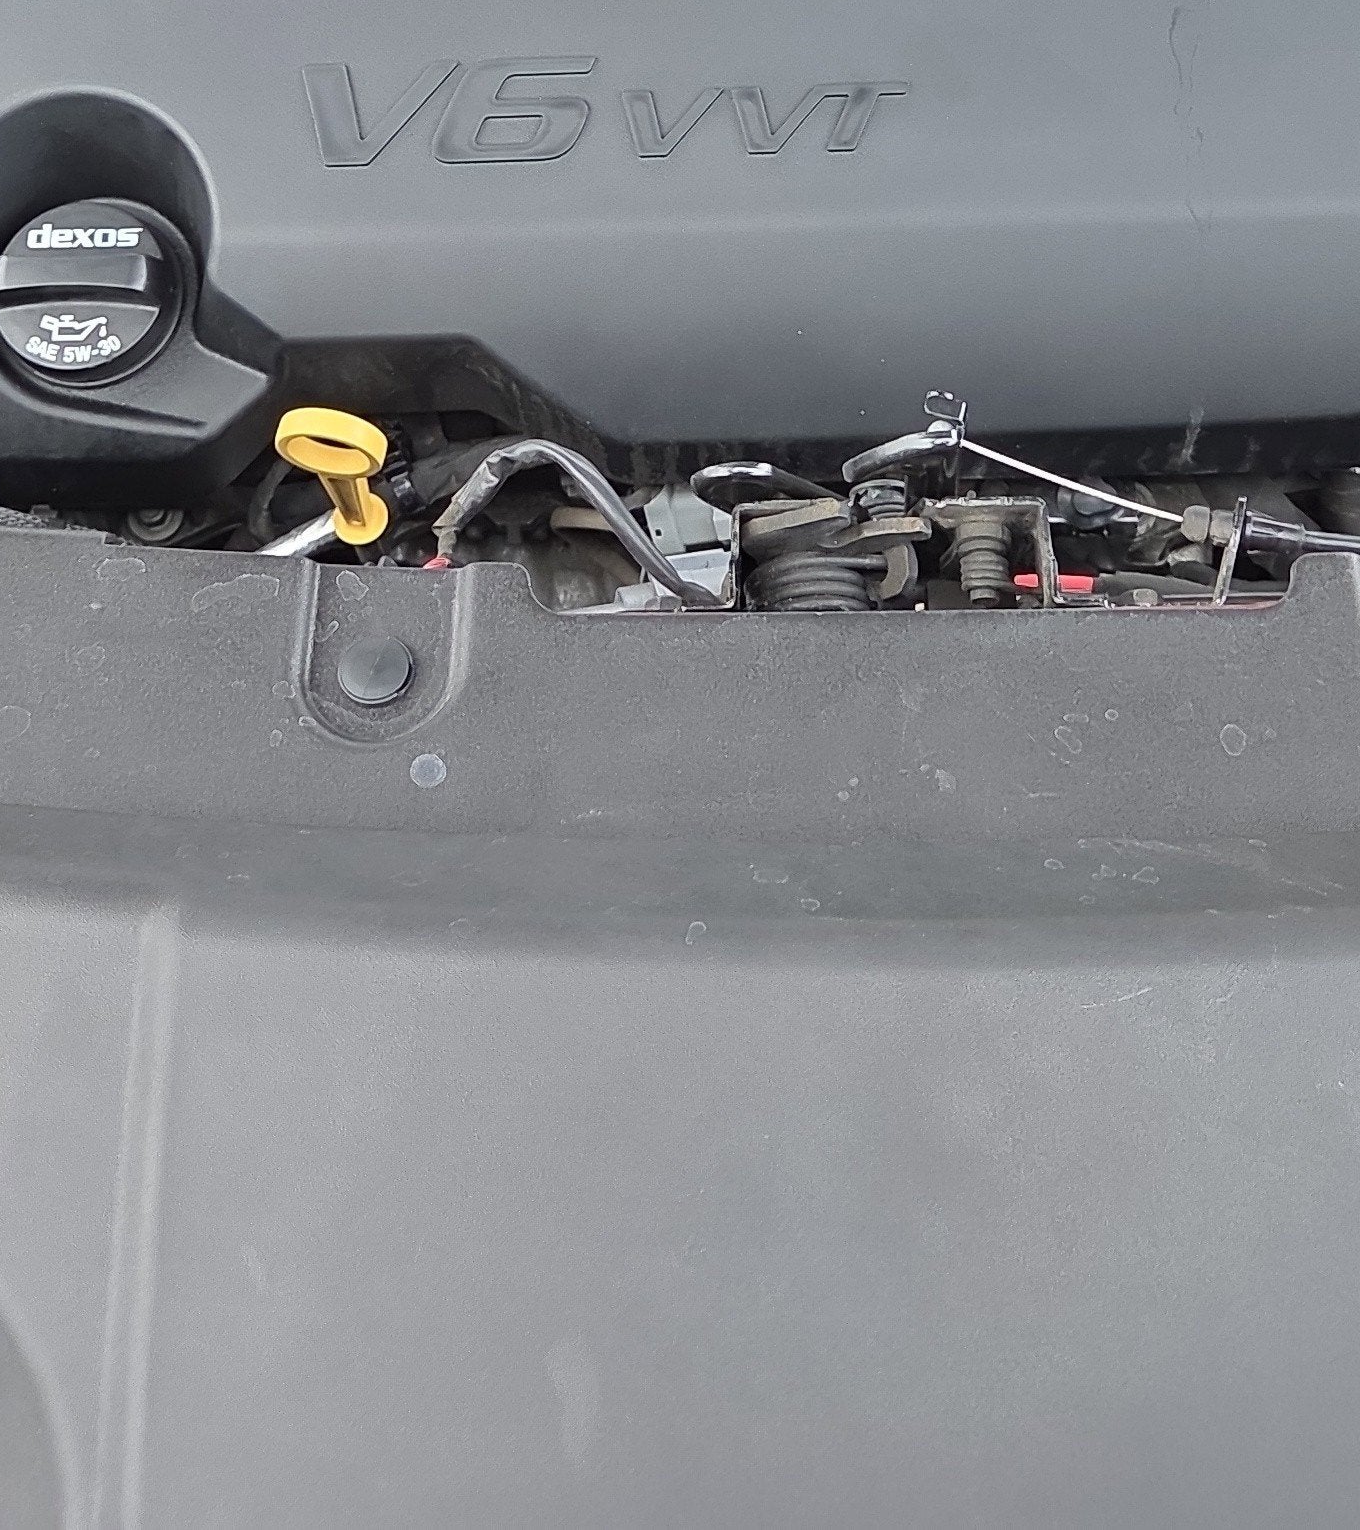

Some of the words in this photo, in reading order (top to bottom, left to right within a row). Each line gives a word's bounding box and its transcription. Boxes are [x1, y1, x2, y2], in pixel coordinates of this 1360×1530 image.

[300, 55, 599, 168] V6
[621, 80, 911, 159] VVT
[26, 223, 144, 249] dexos
[25, 336, 59, 362] SAE
[63, 335, 121, 363] 5W-30
